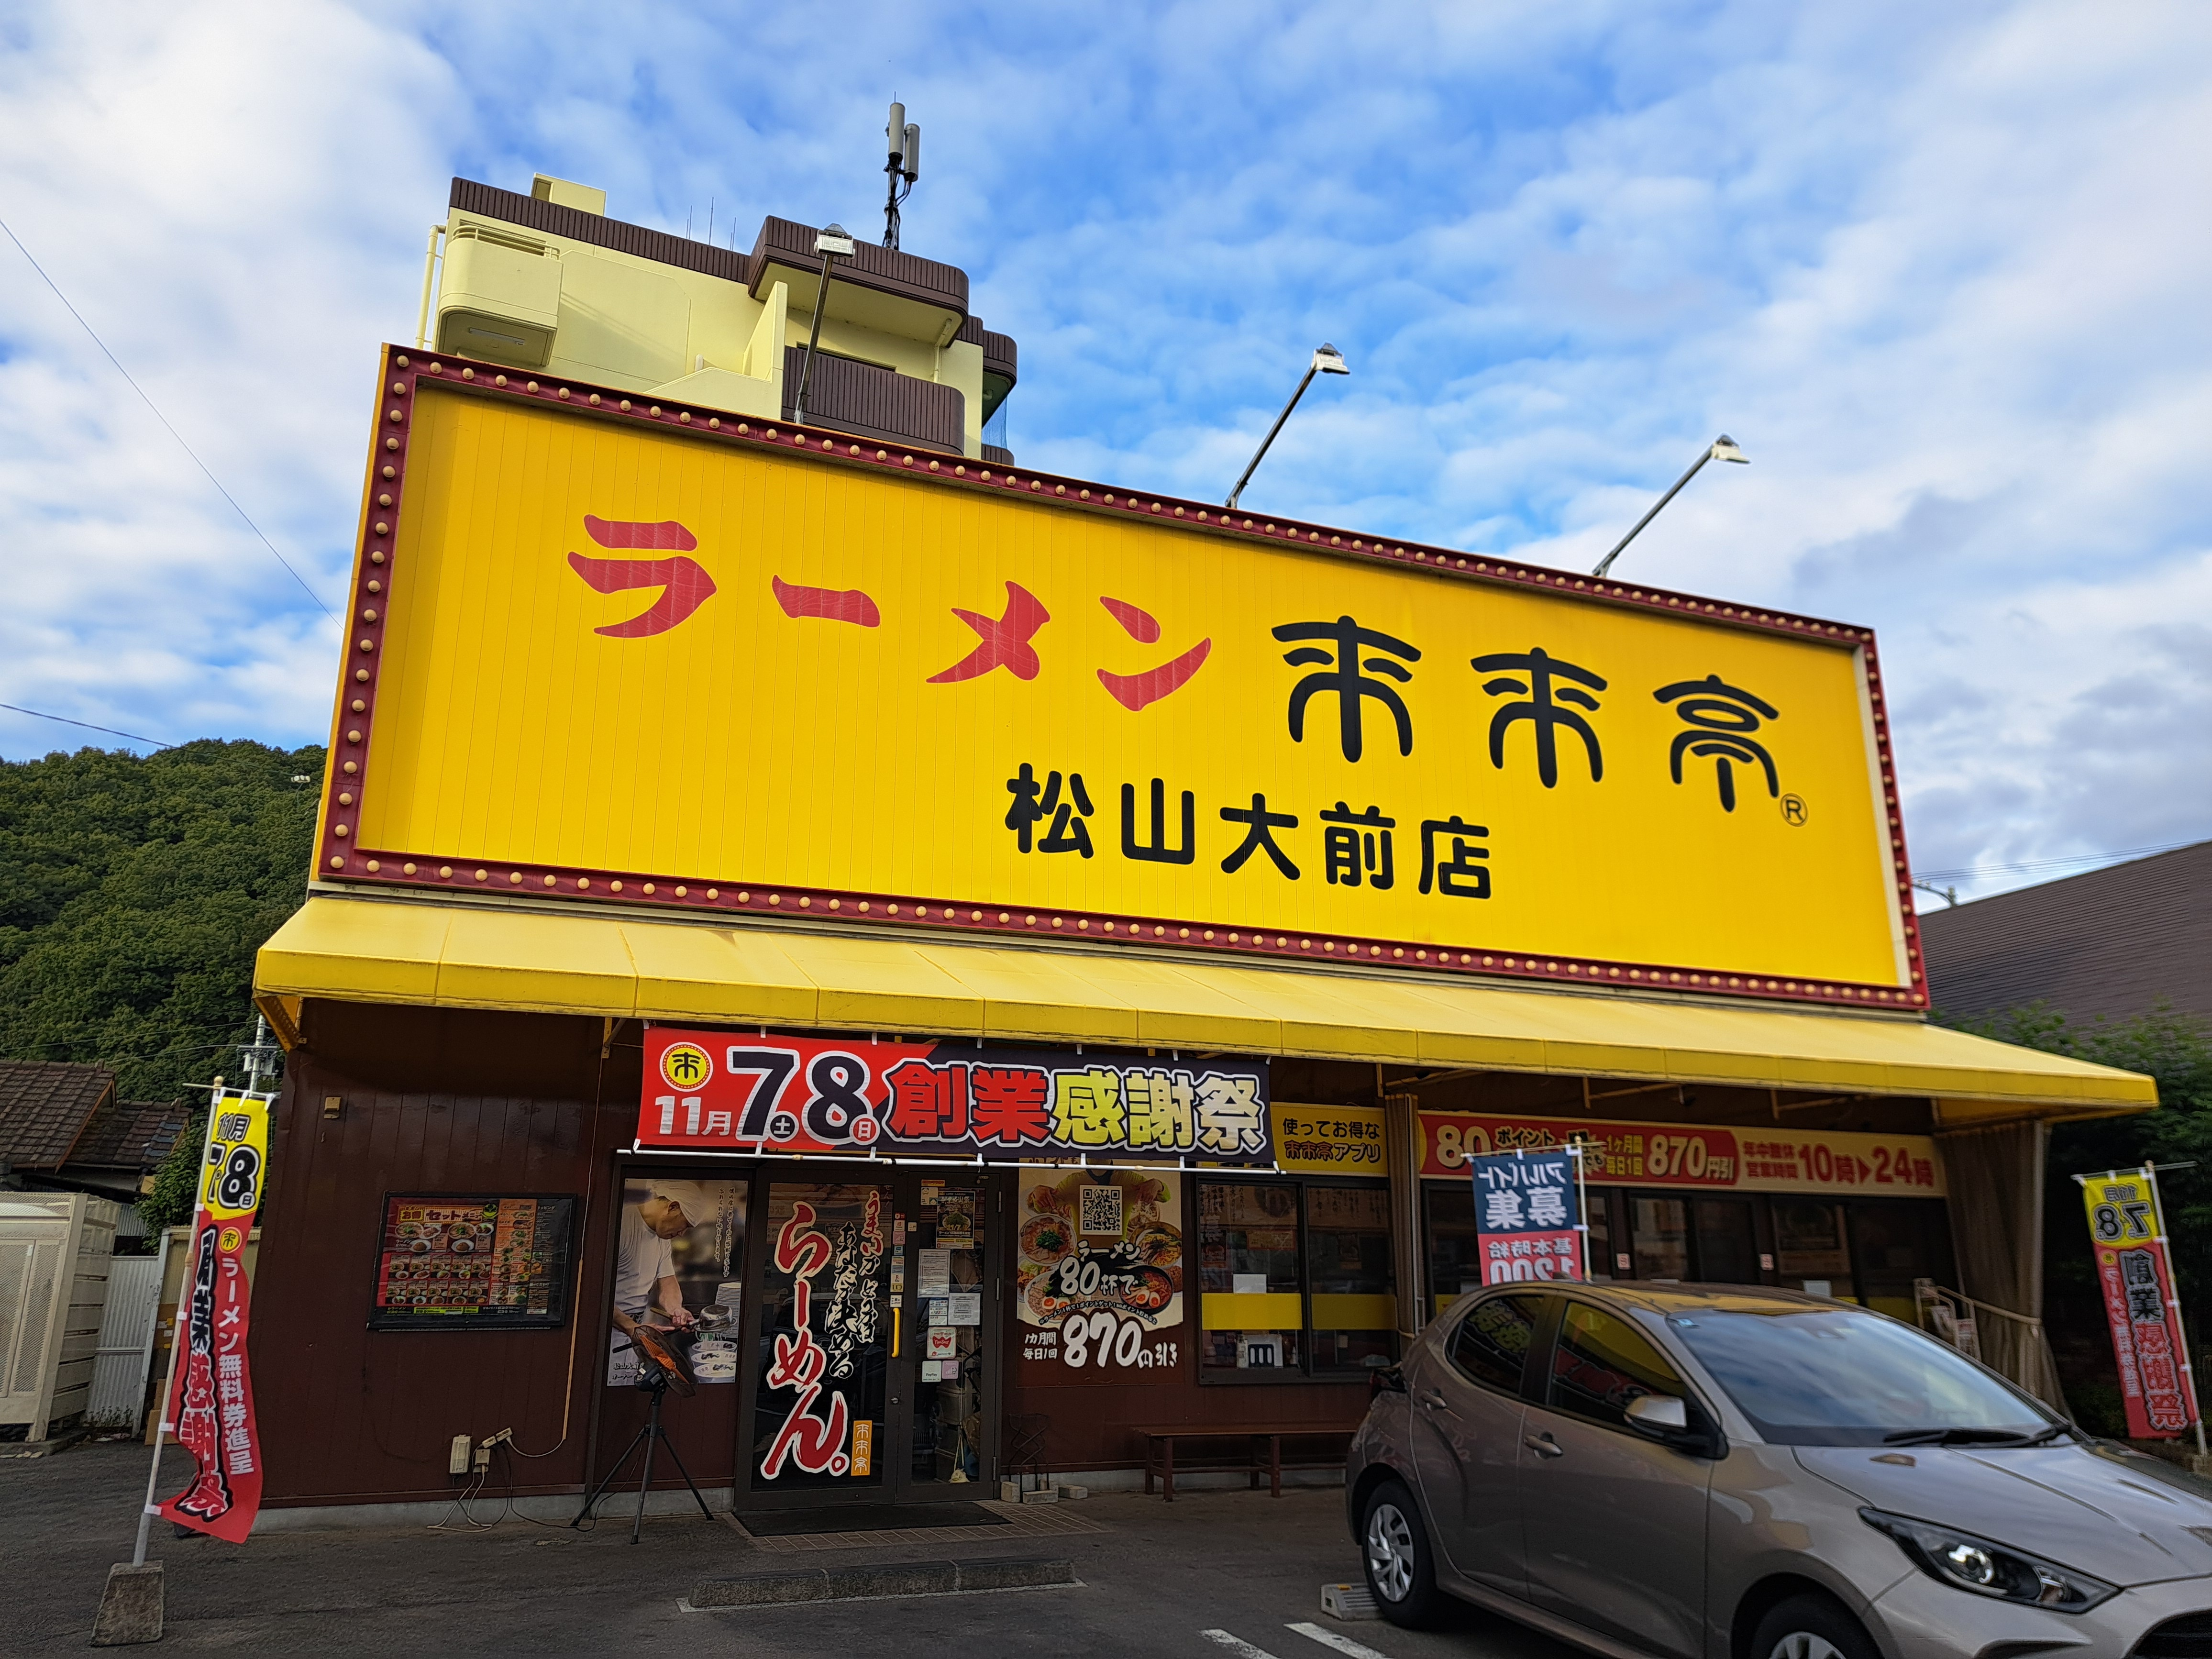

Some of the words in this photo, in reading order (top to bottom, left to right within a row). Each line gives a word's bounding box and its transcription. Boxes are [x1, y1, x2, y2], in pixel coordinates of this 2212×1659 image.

[567, 514, 1211, 711] ラーメン
[1004, 762, 1491, 900] 松山大前店
[883, 1058, 1265, 1155] 創業感謝祭
[1283, 1117, 1380, 1139] 使ってお得な
[1060, 1256, 1139, 1296] 80杯で
[1076, 1239, 1140, 1262] ラーメン
[218, 1257, 255, 1475] ラーメン無料券進呈
[1023, 1347, 1058, 1361] 毎日1回
